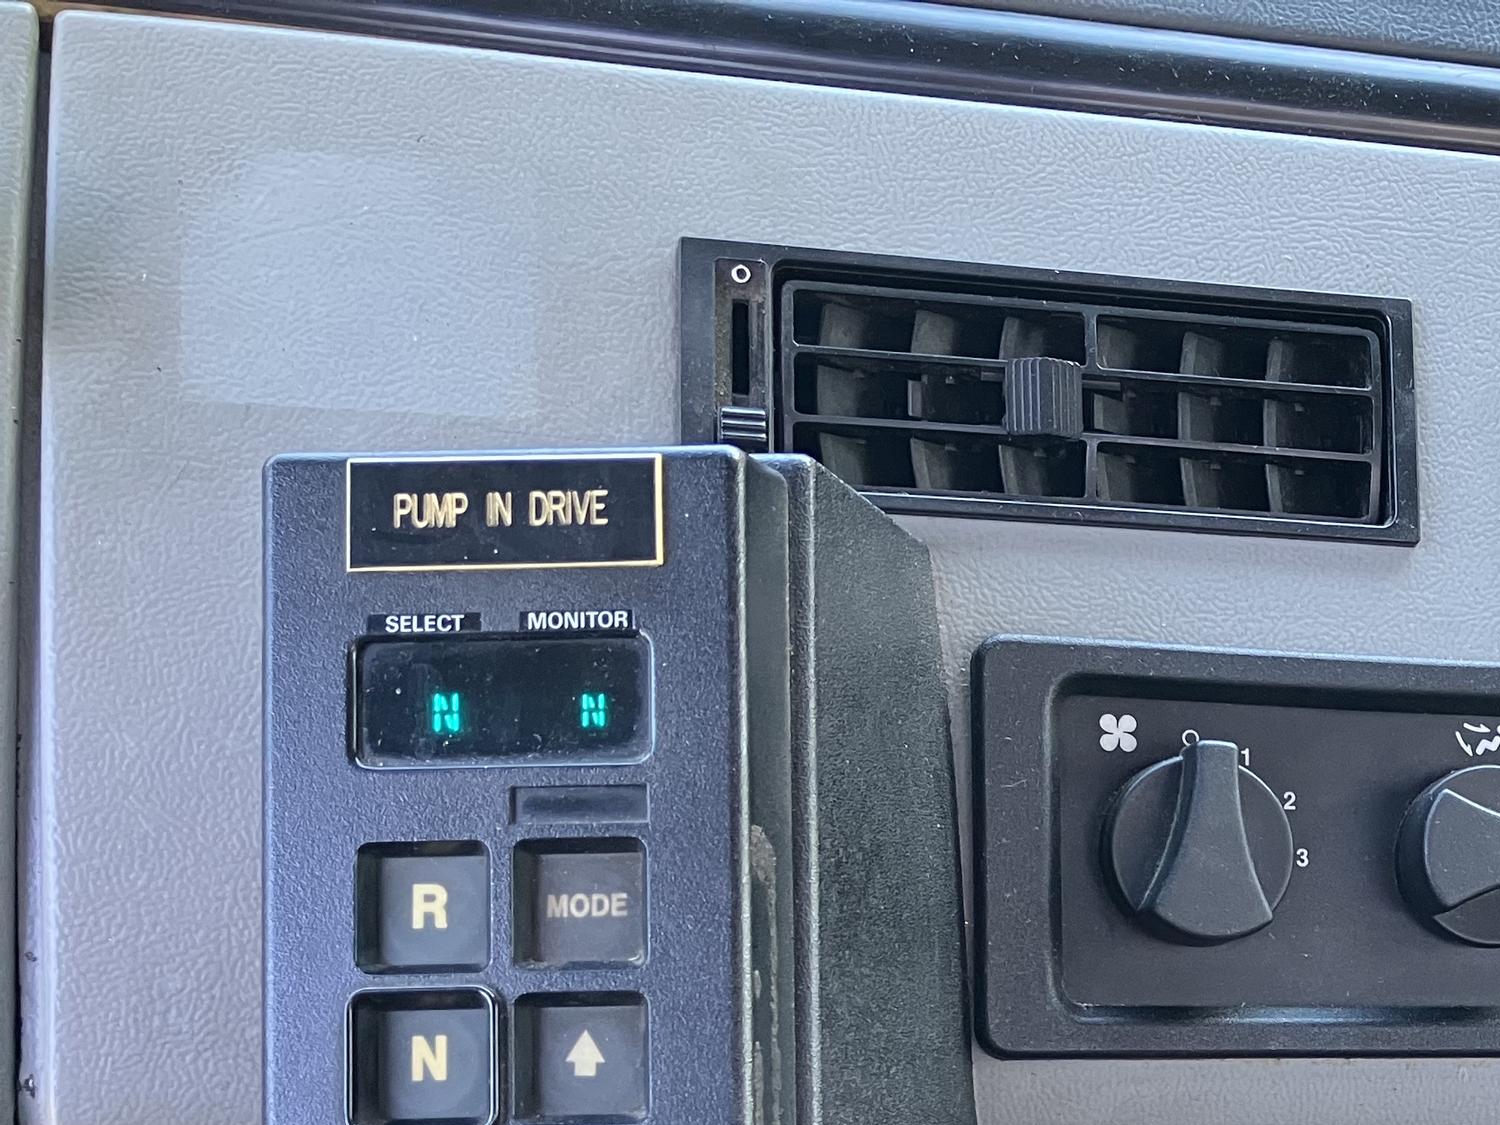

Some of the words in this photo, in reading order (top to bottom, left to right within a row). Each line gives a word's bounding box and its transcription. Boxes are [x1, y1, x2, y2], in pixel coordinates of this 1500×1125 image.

[393, 492, 468, 528] PUMP
[486, 491, 512, 527] IN
[528, 489, 609, 526] DRIVE
[385, 615, 464, 632] SELECT
[528, 610, 628, 630] MONITOR
[432, 692, 460, 732] N
[581, 692, 607, 728] N
[1241, 748, 1250, 766] 1
[1283, 791, 1296, 810] 2
[1296, 848, 1309, 867] 3
[411, 883, 448, 929] R
[546, 893, 628, 918] MODE
[411, 1034, 447, 1082] N
